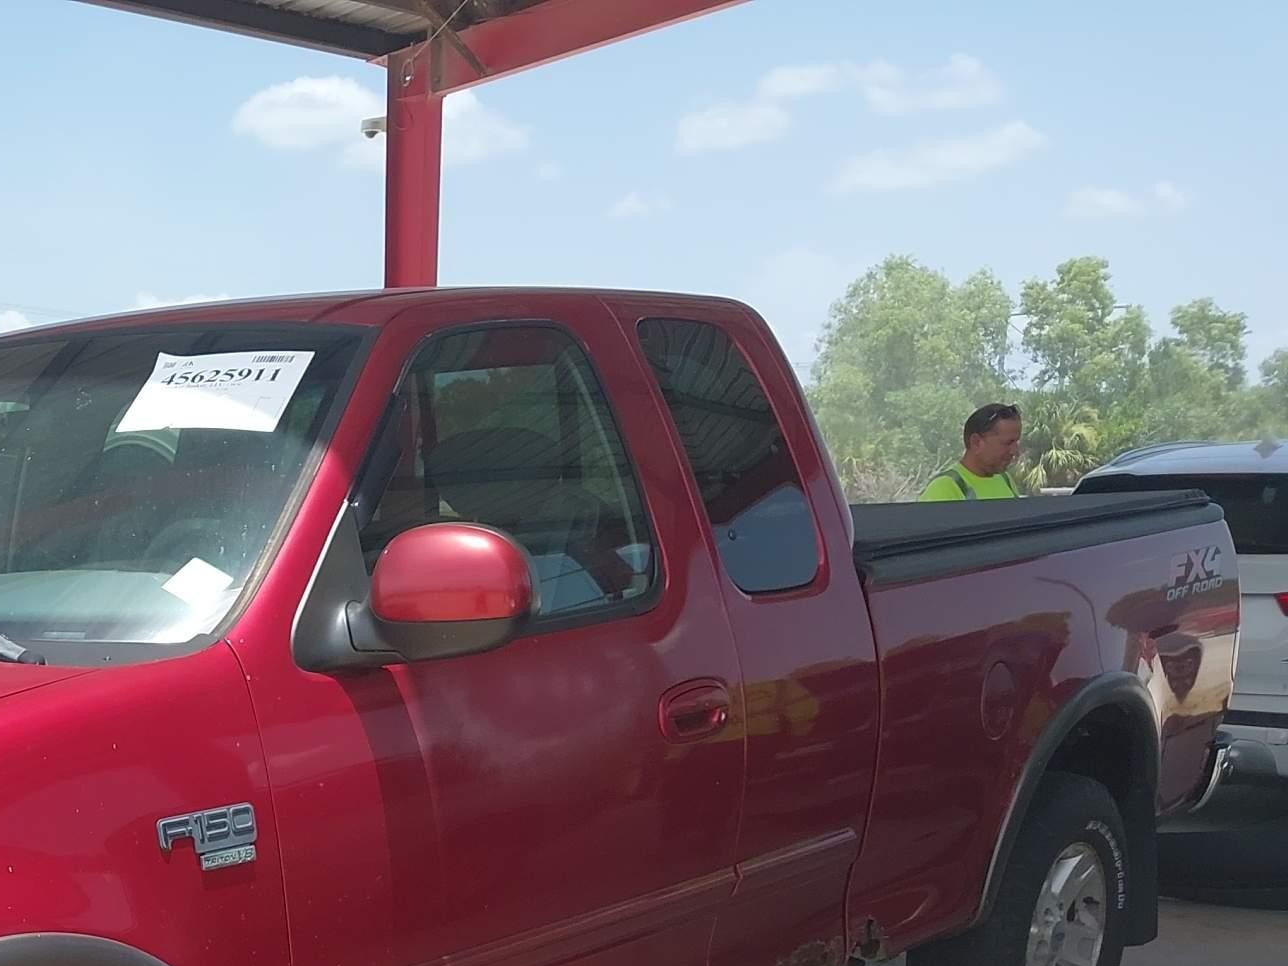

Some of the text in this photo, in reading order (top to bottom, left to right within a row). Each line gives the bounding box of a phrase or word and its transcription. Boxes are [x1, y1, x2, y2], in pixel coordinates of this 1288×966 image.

[161, 368, 283, 385] 45625911
[1168, 546, 1222, 587] FX4
[1167, 576, 1223, 602] OFF ROAD
